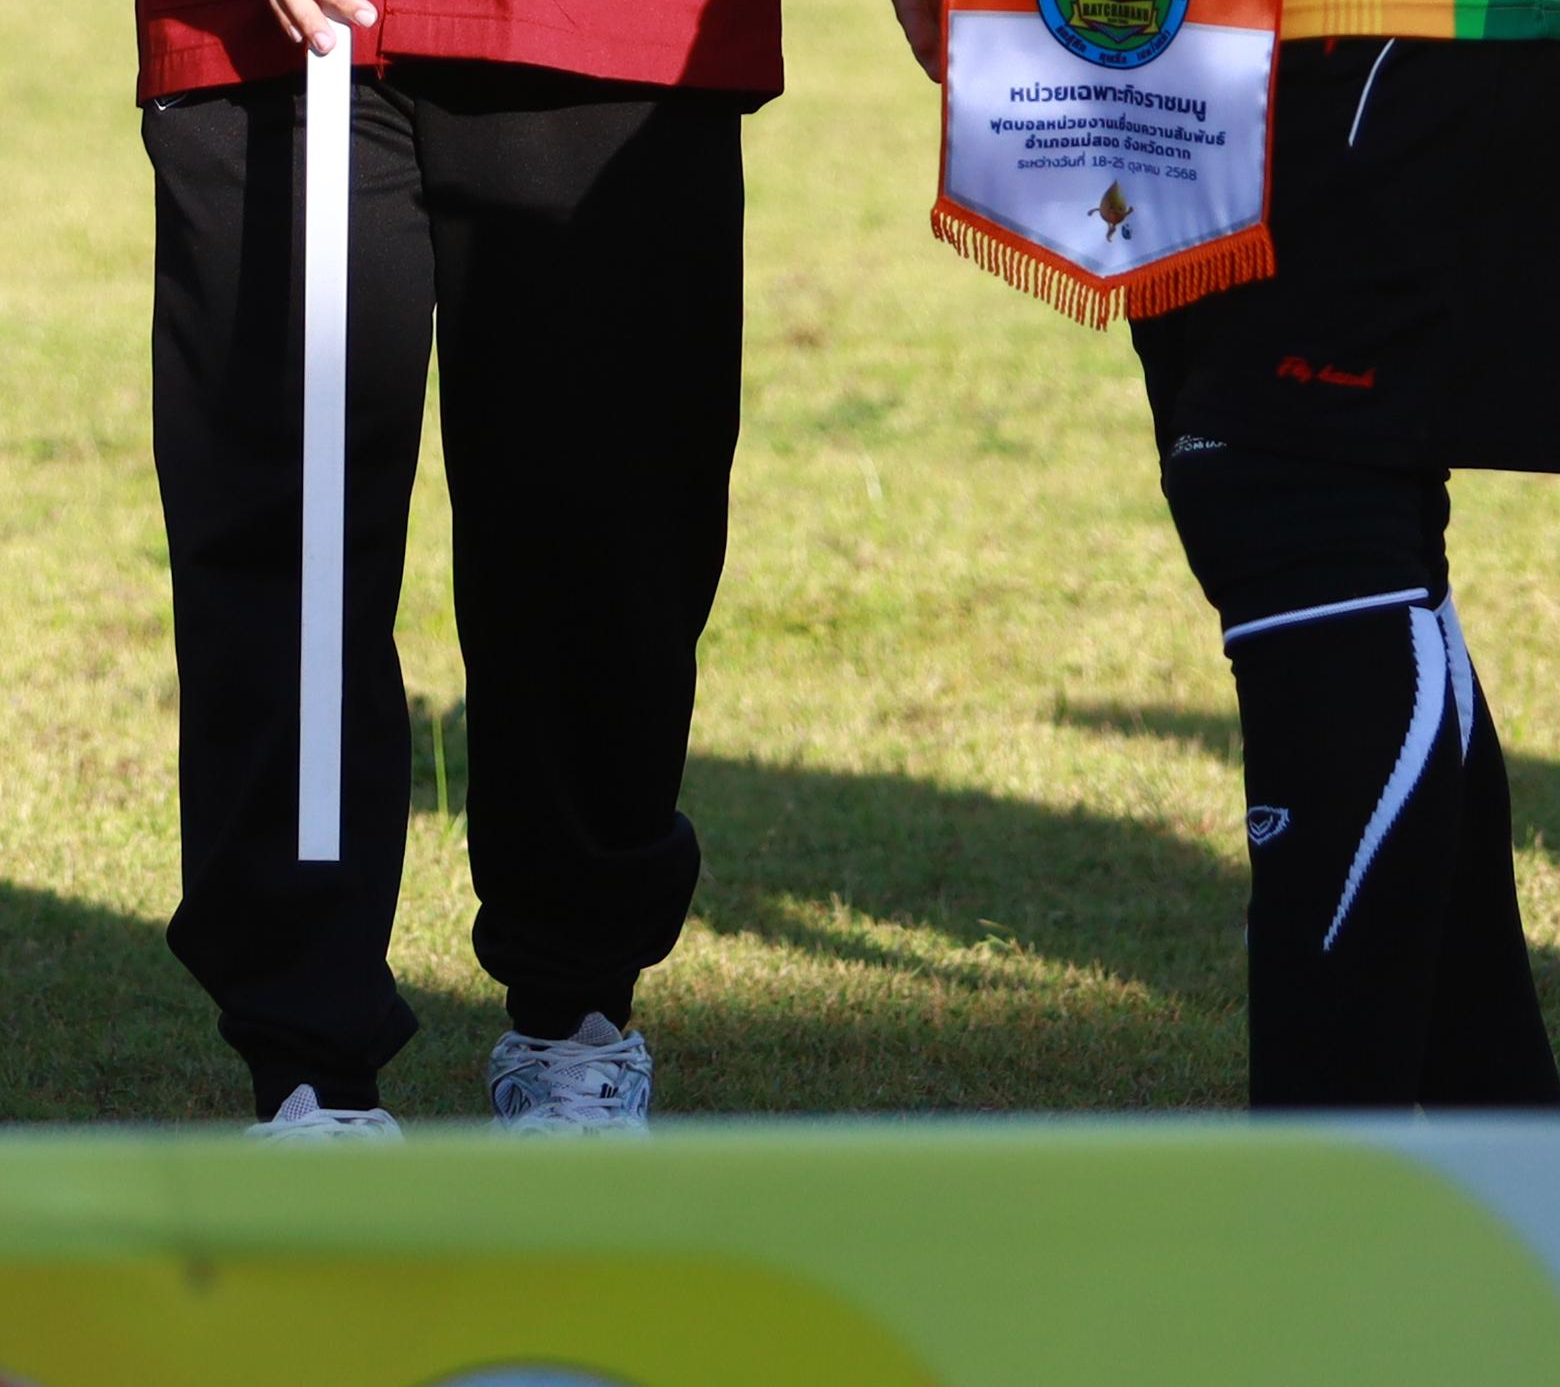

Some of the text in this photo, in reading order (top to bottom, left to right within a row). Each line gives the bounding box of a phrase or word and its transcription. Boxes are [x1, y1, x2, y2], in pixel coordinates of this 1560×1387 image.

[1009, 81, 1208, 122] หน่วยเฉพาะกิจราชมนู
[1024, 132, 1192, 160] อำเภอแม่สอด จังหวัดตาก
[1016, 151, 1086, 170] ระหว่างวันที่
[1091, 155, 1126, 170] 18-25
[1164, 164, 1198, 182] 2568
